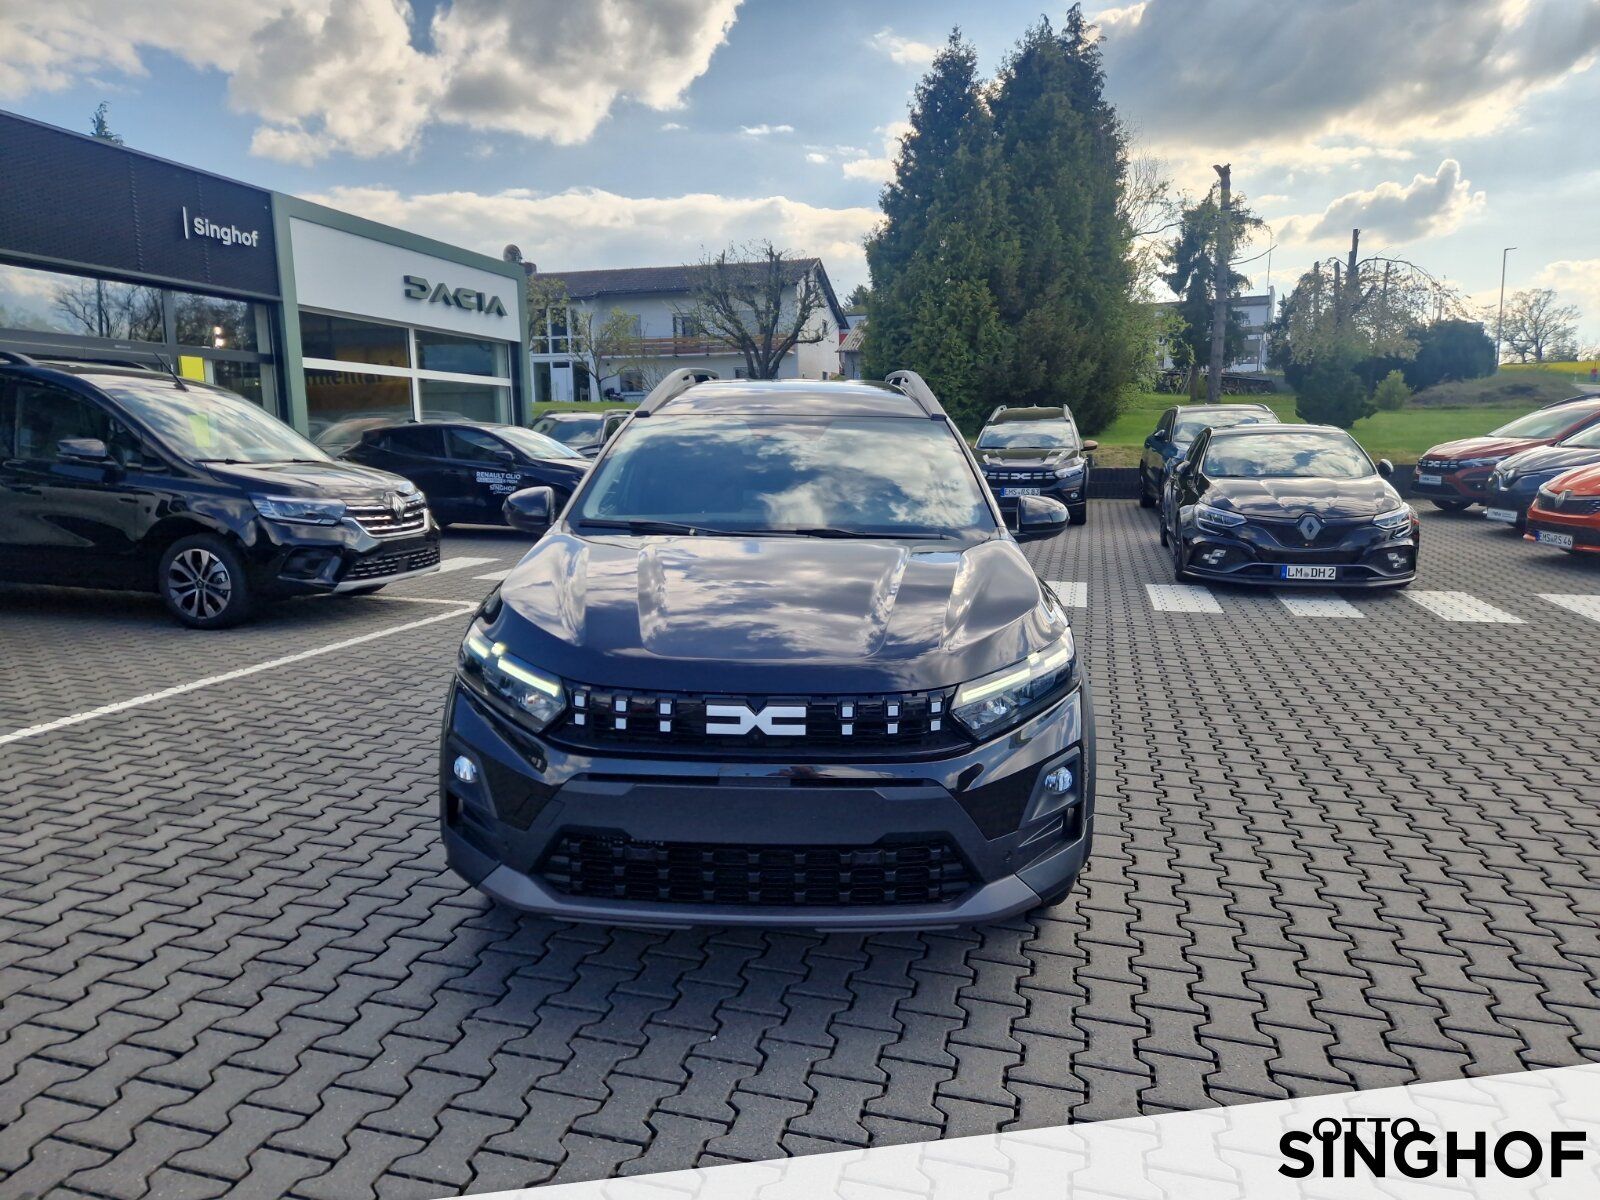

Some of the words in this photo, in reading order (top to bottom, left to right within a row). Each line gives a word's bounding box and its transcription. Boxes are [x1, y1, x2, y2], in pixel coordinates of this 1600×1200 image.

[193, 217, 258, 247] Singhof
[403, 275, 508, 316] DACIA
[1287, 567, 1303, 578] LM
[1310, 567, 1326, 578] DH
[1327, 568, 1335, 579] 2
